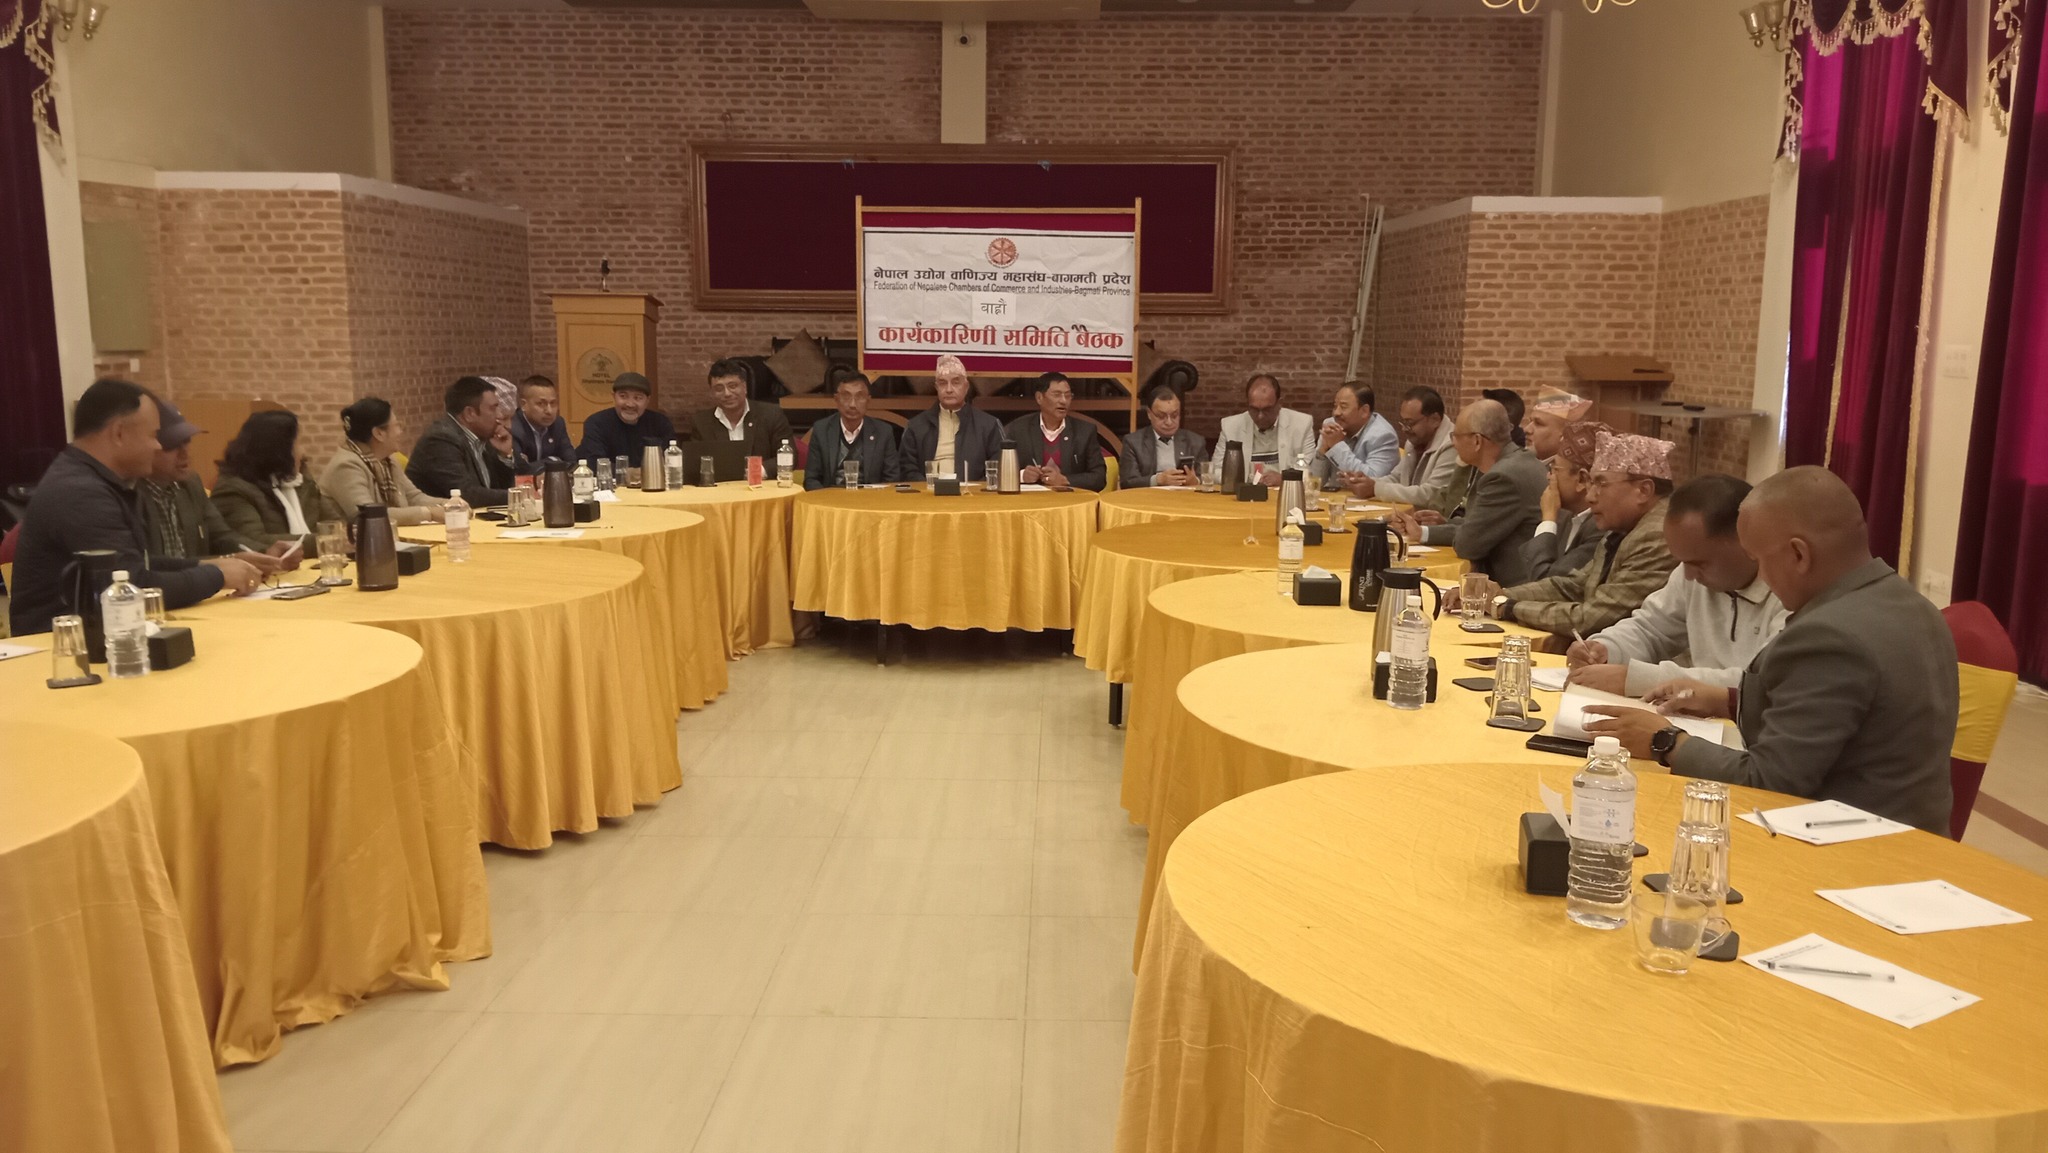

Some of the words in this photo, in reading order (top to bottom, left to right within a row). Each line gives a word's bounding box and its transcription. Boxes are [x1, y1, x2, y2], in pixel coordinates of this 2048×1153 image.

[874, 267, 909, 280] नेपाल
[914, 268, 946, 280] उद्योग
[950, 268, 998, 281] वाणिज्य
[1102, 272, 1131, 285] प्रदेश
[873, 281, 908, 291] Federation
[909, 282, 917, 291] of
[917, 282, 947, 292] Nepalese
[949, 282, 982, 292] Chambers
[983, 283, 990, 292] of
[991, 283, 1026, 294] Commerce
[1027, 285, 1040, 294] and
[1102, 286, 1131, 296] Province
[878, 321, 997, 345] कार्यकारिणी
[1003, 325, 1070, 347] समिति
[1071, 324, 1124, 349] बैठक
